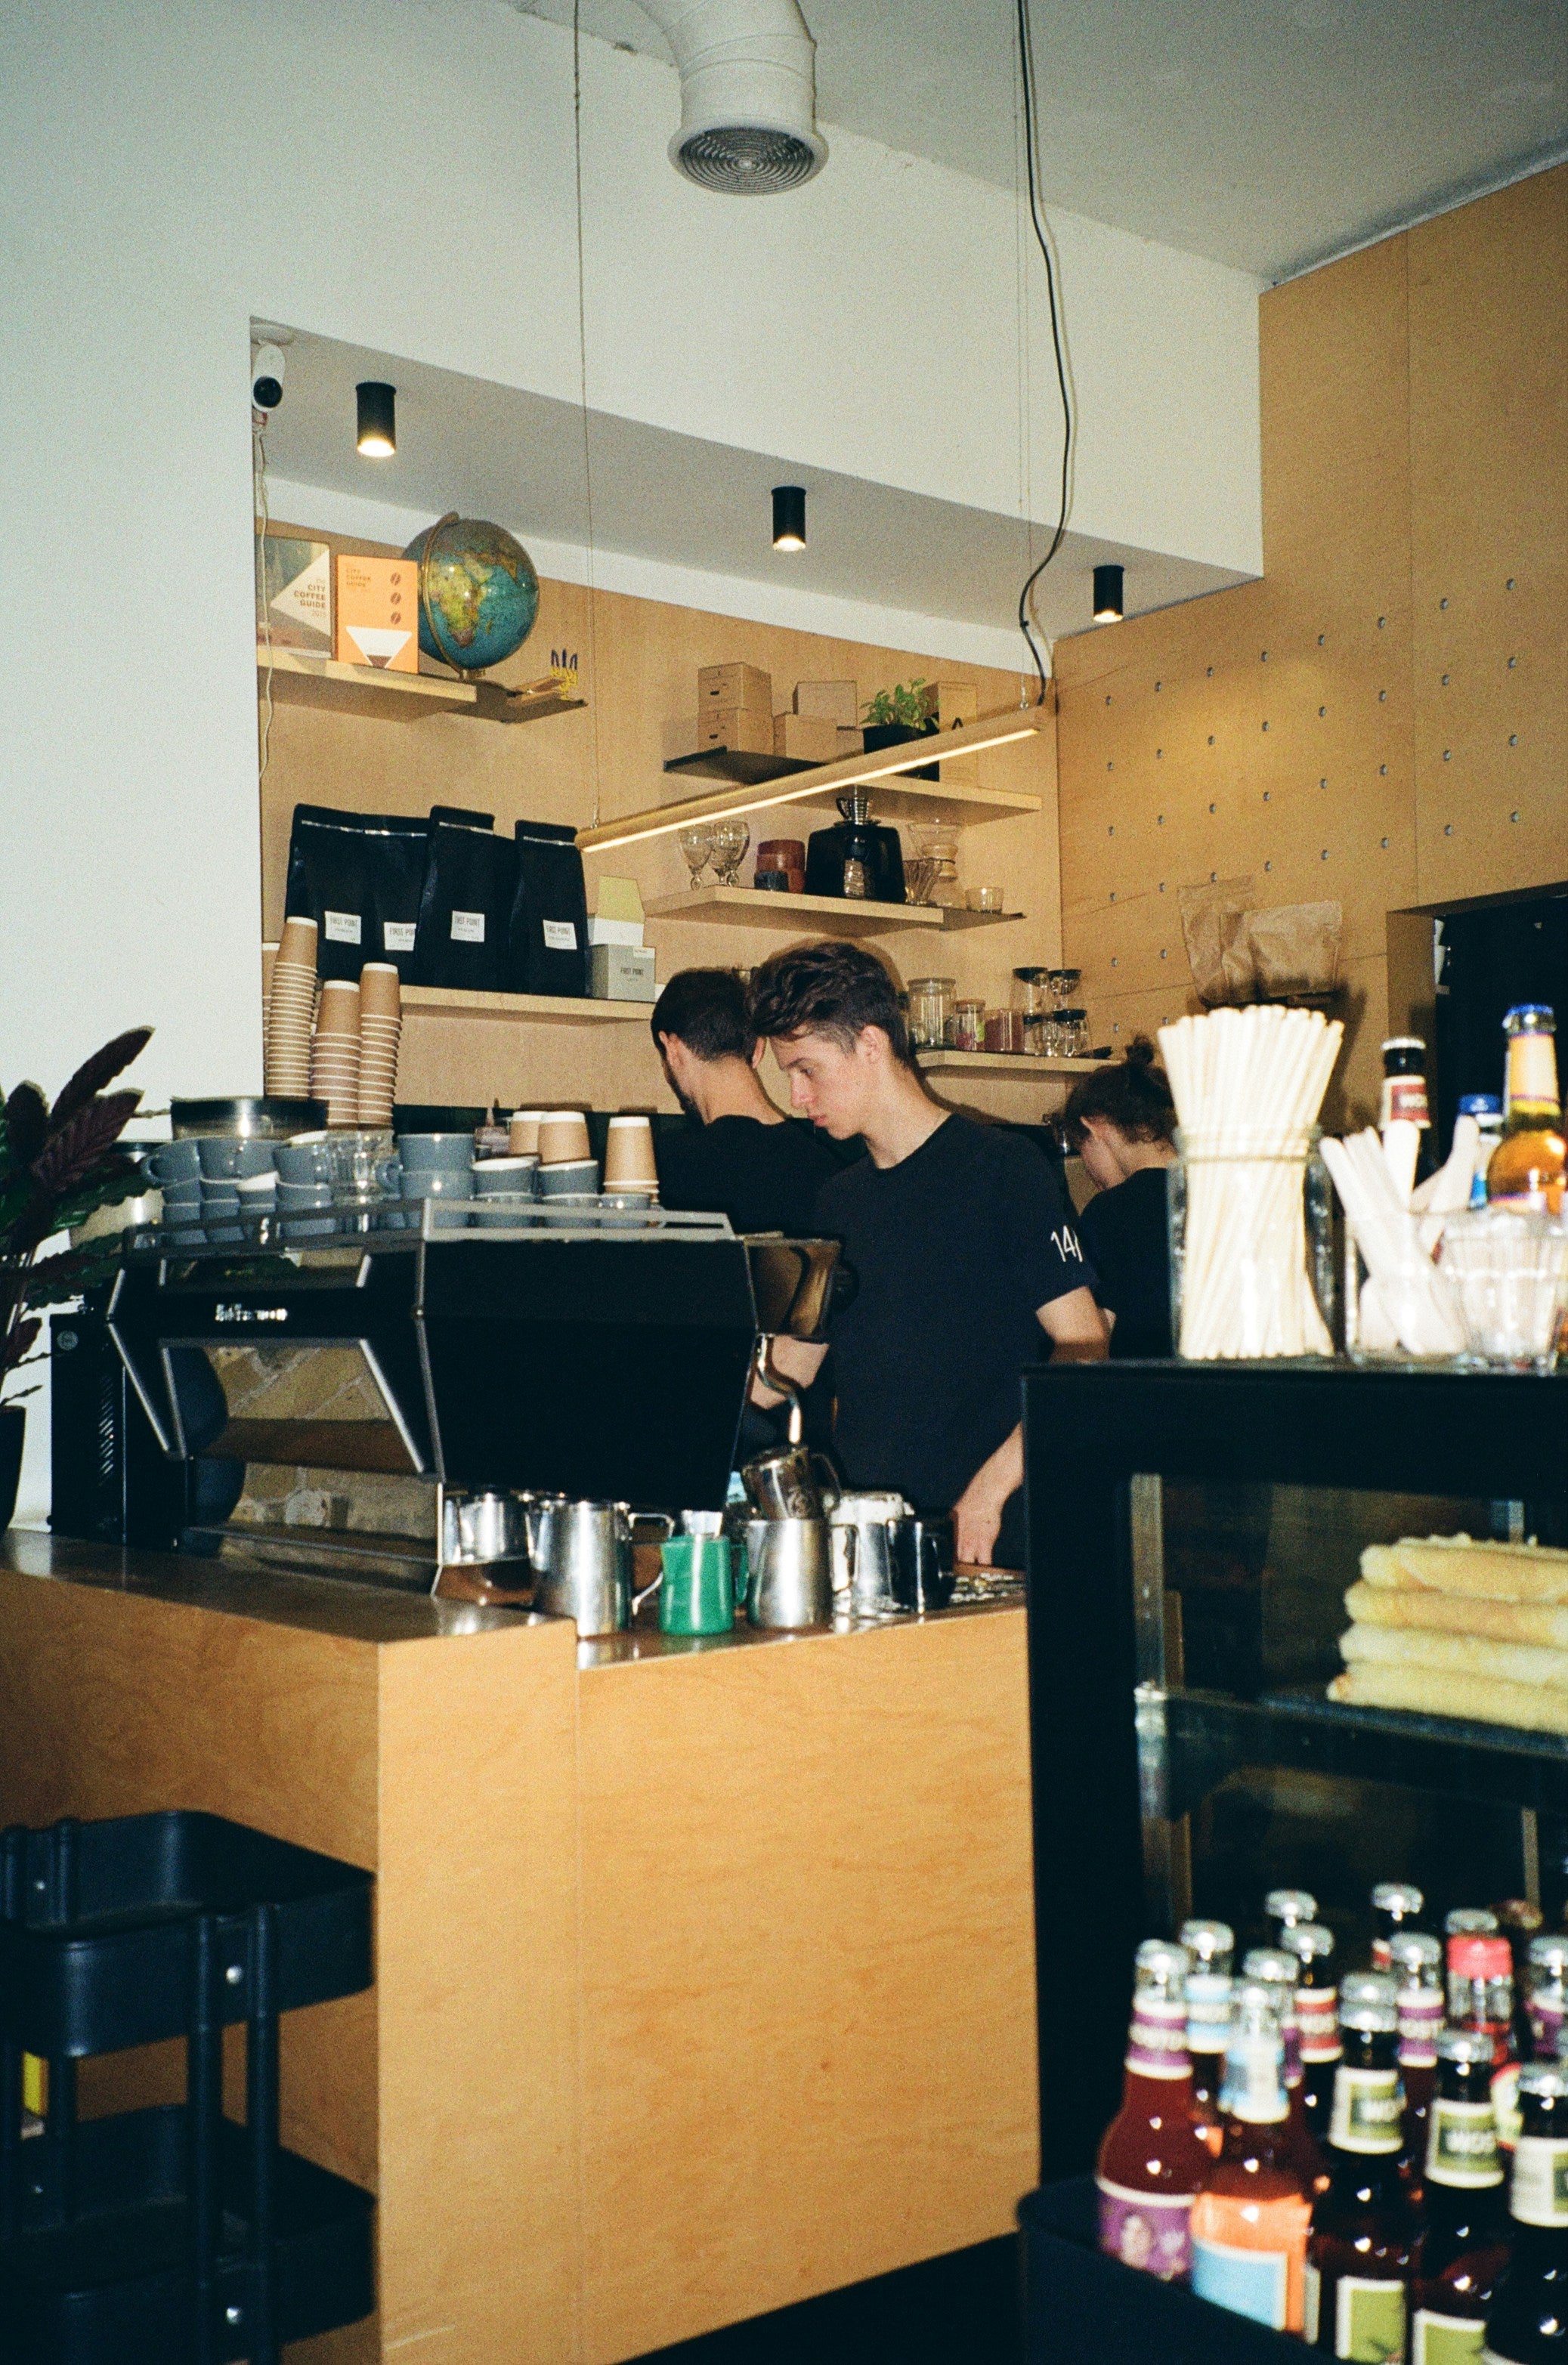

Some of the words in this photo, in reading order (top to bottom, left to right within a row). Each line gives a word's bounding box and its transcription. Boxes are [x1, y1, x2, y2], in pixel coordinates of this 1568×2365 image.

[308, 584, 326, 592] CITY
[293, 590, 326, 601] COFFEE
[299, 599, 326, 609] GUIDE
